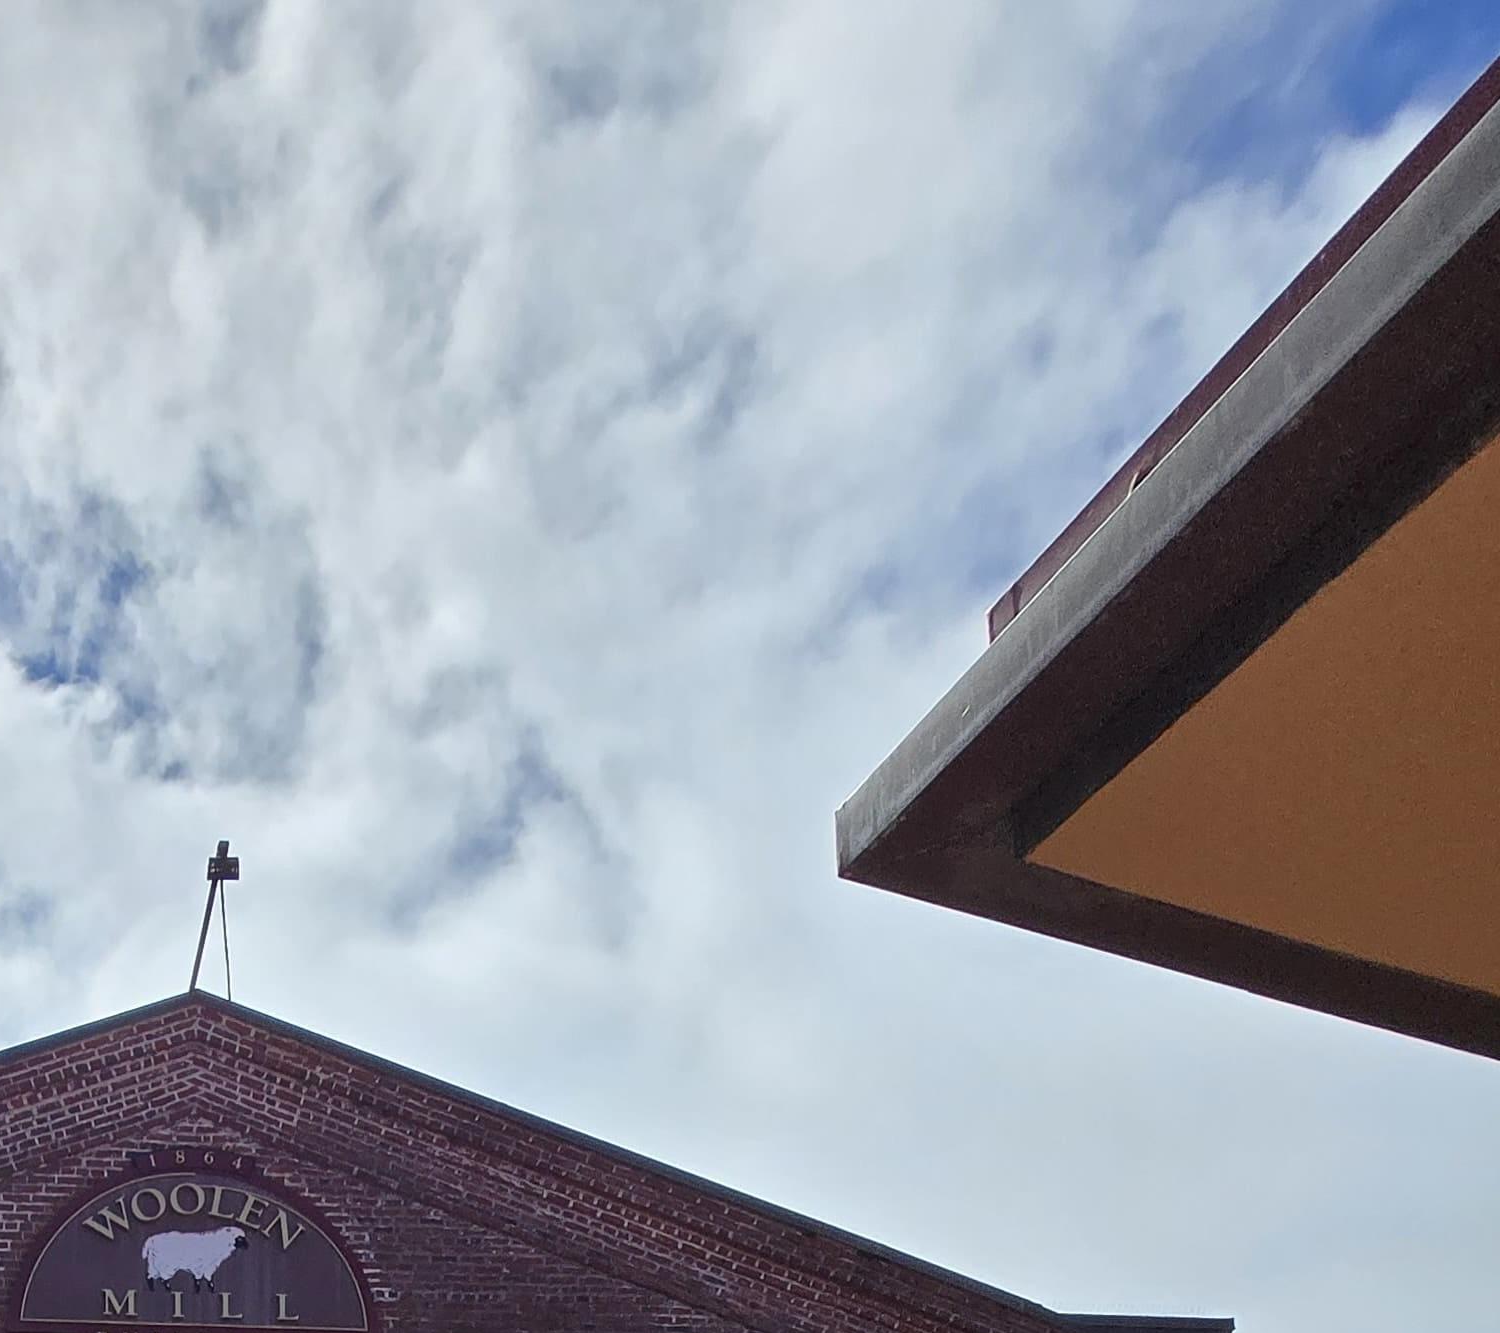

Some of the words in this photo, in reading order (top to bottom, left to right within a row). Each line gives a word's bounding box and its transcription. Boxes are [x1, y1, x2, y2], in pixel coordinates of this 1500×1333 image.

[148, 1151, 243, 1170] 1864
[82, 1183, 306, 1250] WOOLEN
[101, 1288, 300, 1321] MILL
